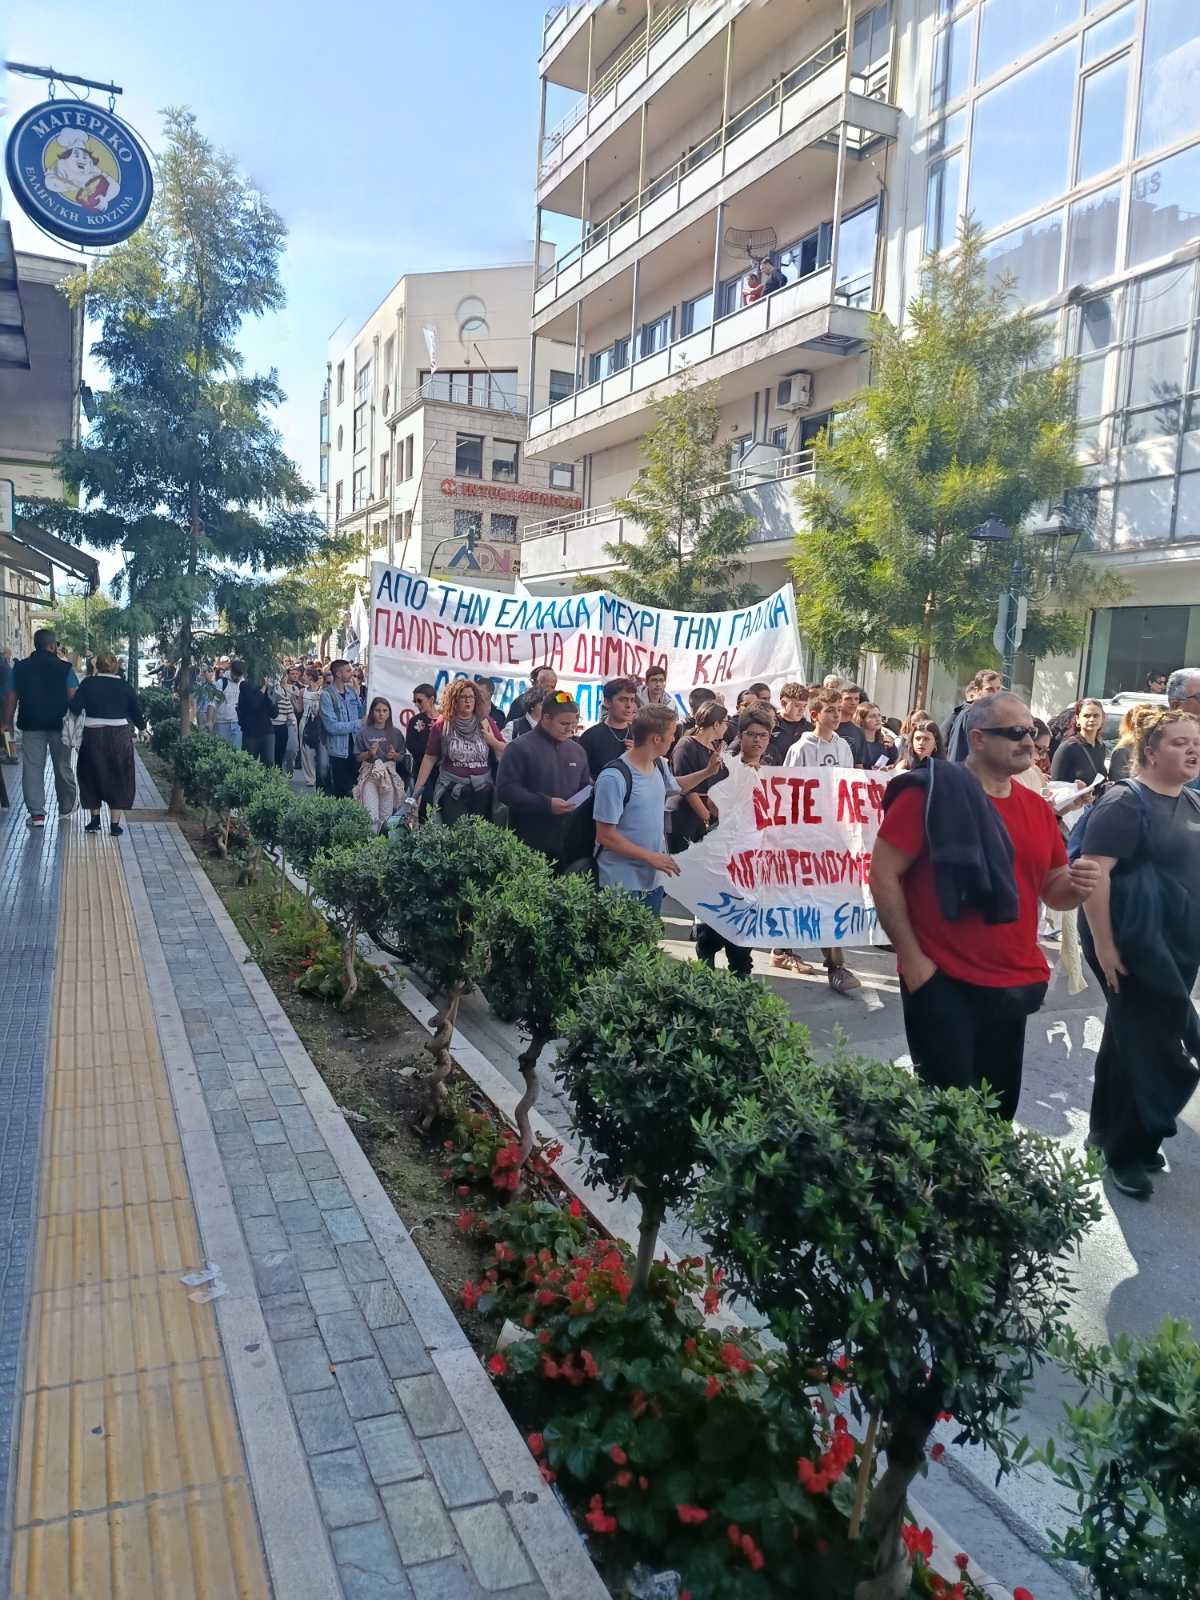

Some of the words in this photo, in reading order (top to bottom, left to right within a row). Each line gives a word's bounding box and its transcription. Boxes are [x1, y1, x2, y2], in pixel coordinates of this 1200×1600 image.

[32, 111, 132, 162] ΜΑΓΕΡΙΚΟ
[26, 167, 79, 221] ΕΛΛΗΝΙΚΗ
[86, 196, 133, 225] ΚΟΥΖΙΝΑ
[376, 570, 428, 611] ΑΠΟ
[438, 585, 490, 627] ΤΗΝ
[494, 597, 590, 631] ΕΛΛΑΔΑ
[598, 595, 659, 647] ΜΕΧΡΙ
[673, 614, 722, 650] ΤΗΝ
[529, 630, 565, 673] ΓΙΑ
[691, 647, 738, 686] ΚΑΙ
